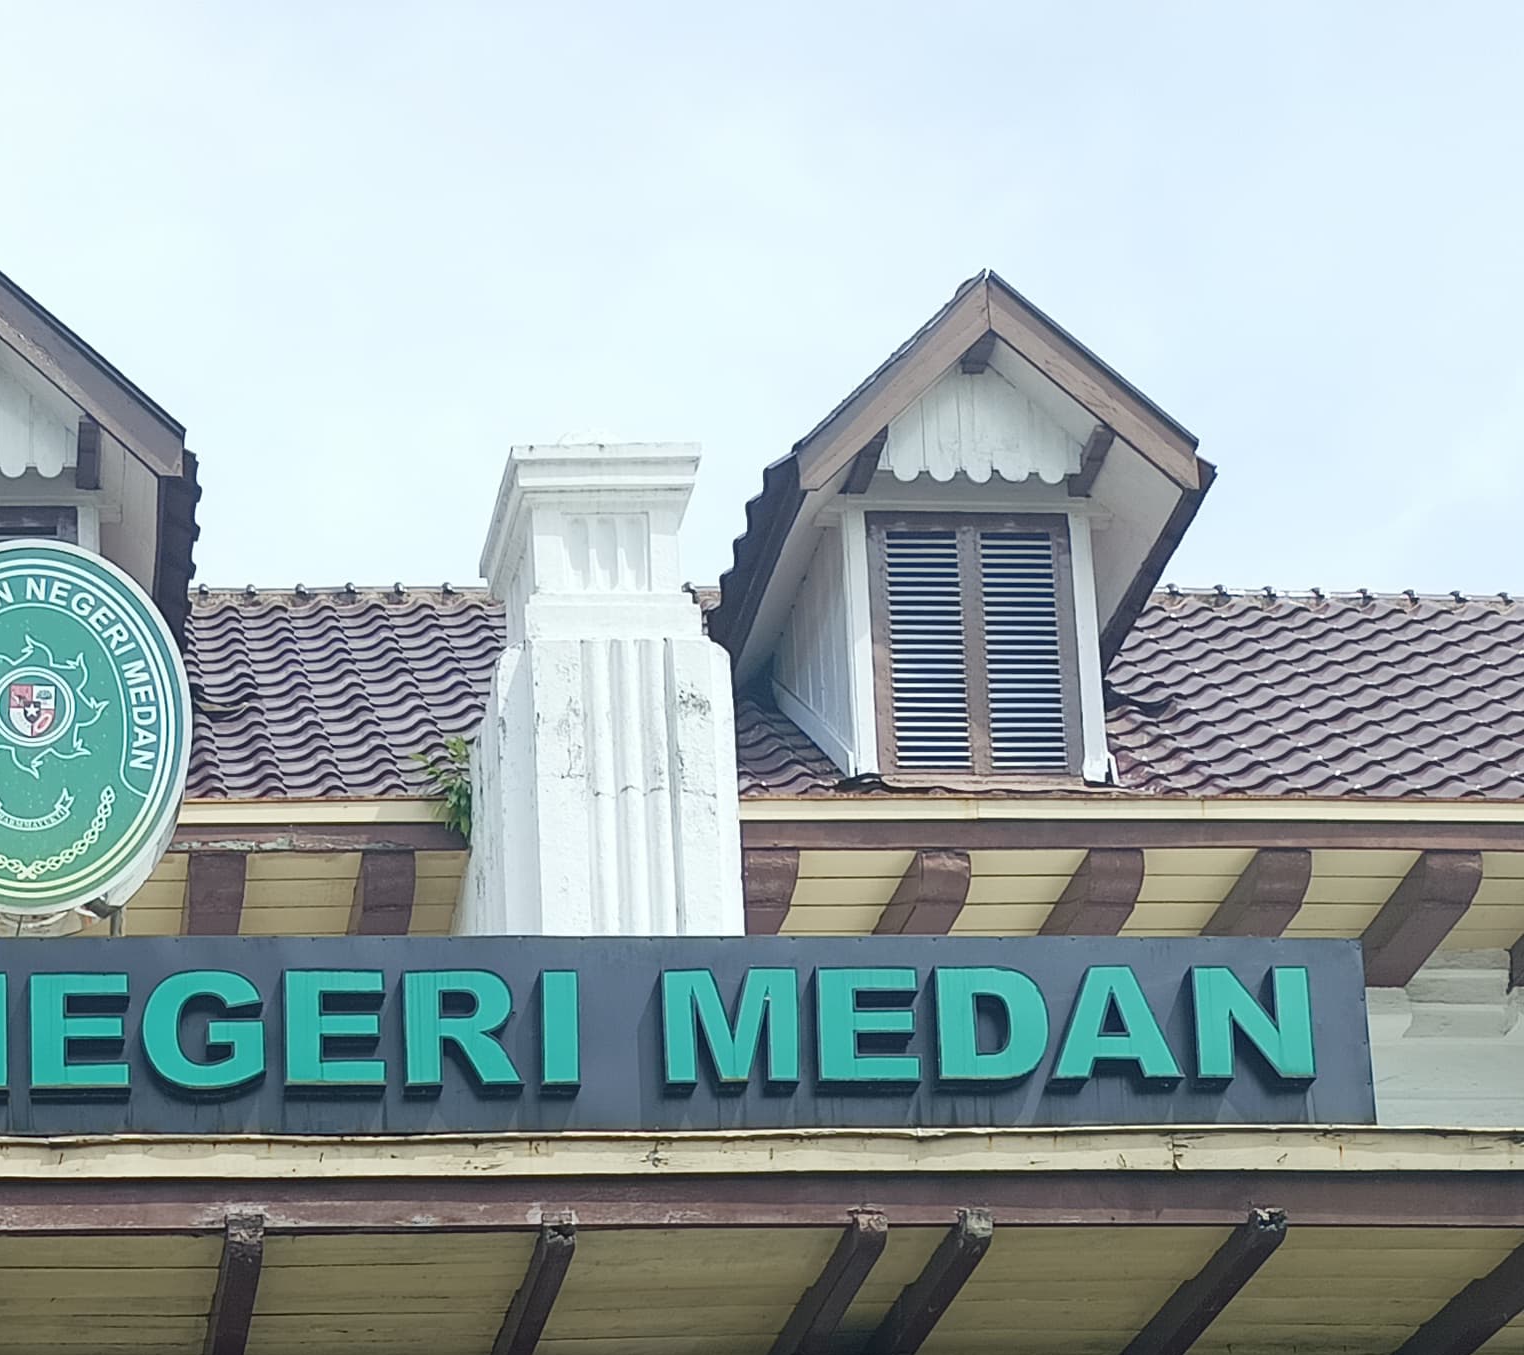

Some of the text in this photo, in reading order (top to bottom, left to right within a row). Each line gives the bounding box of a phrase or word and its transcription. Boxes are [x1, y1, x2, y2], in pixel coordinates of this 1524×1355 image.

[26, 577, 136, 658] NEGERI
[122, 658, 157, 771] MEDAN
[664, 965, 1316, 1090] MEDAN
